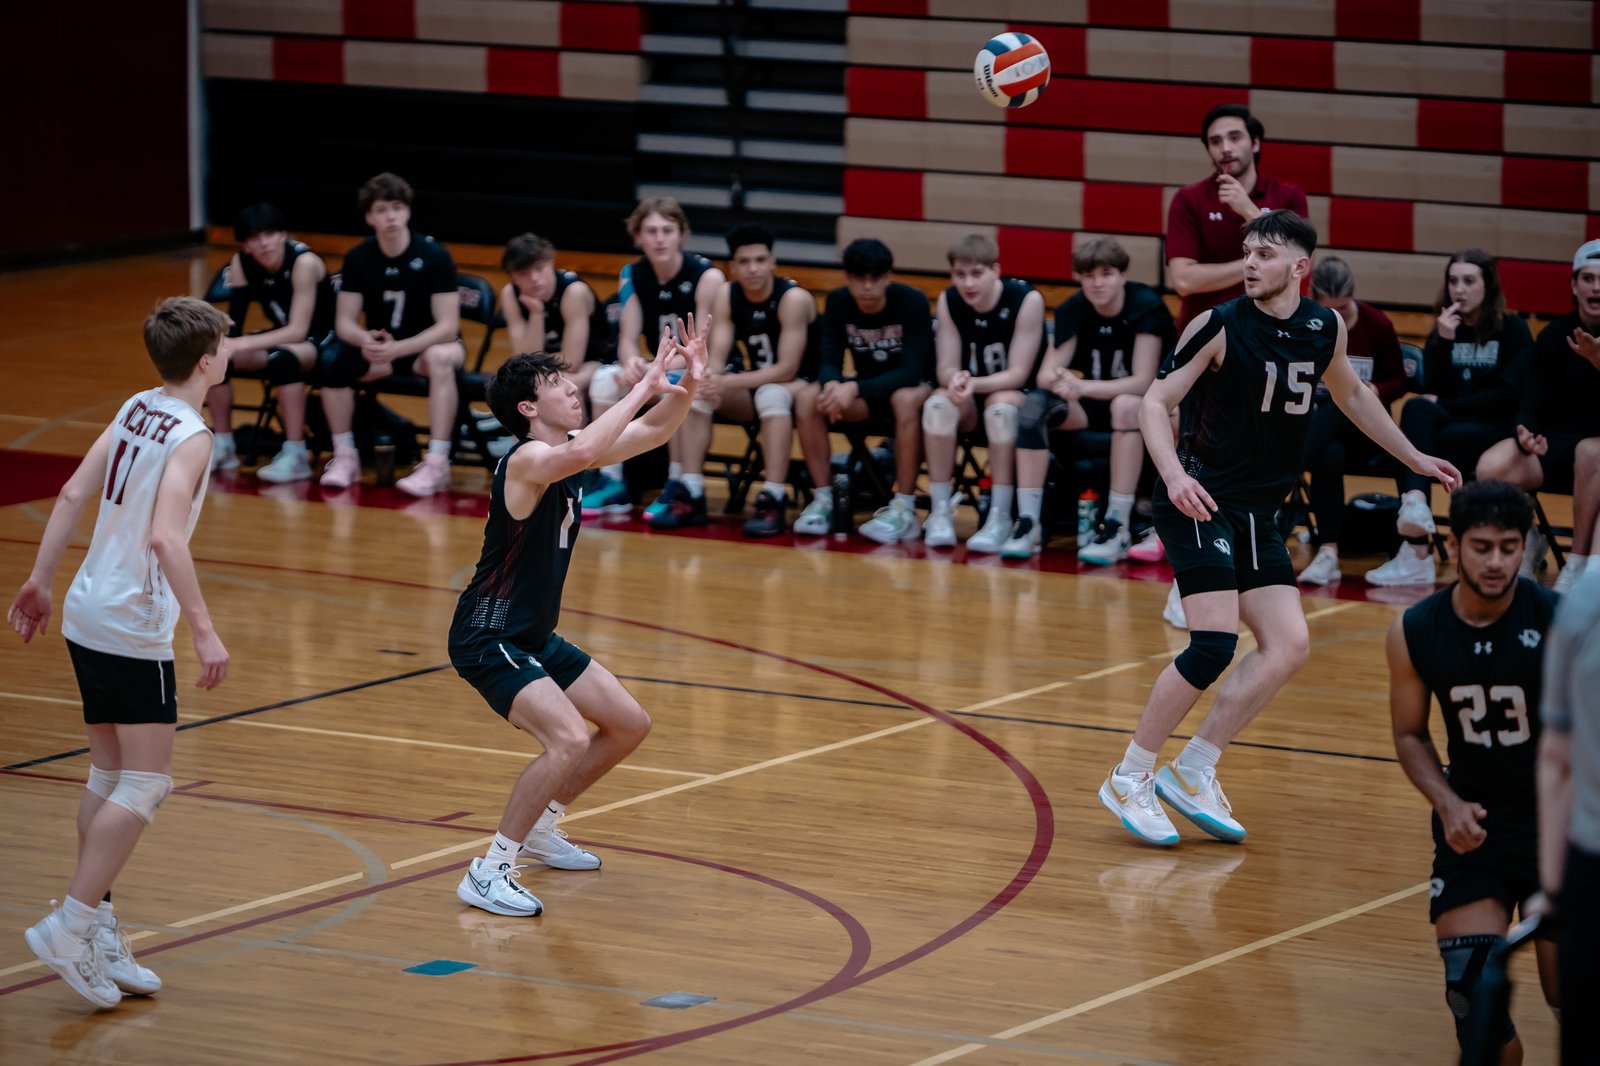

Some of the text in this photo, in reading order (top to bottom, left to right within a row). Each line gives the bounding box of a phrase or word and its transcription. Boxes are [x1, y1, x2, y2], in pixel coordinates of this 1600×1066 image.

[383, 289, 406, 330] 7
[748, 333, 774, 369] 3
[968, 342, 1008, 377] 18
[1091, 348, 1130, 379] 14
[1261, 360, 1315, 415] 15
[118, 398, 183, 445] OTH
[105, 438, 141, 505] 11
[1449, 684, 1532, 749] 23
